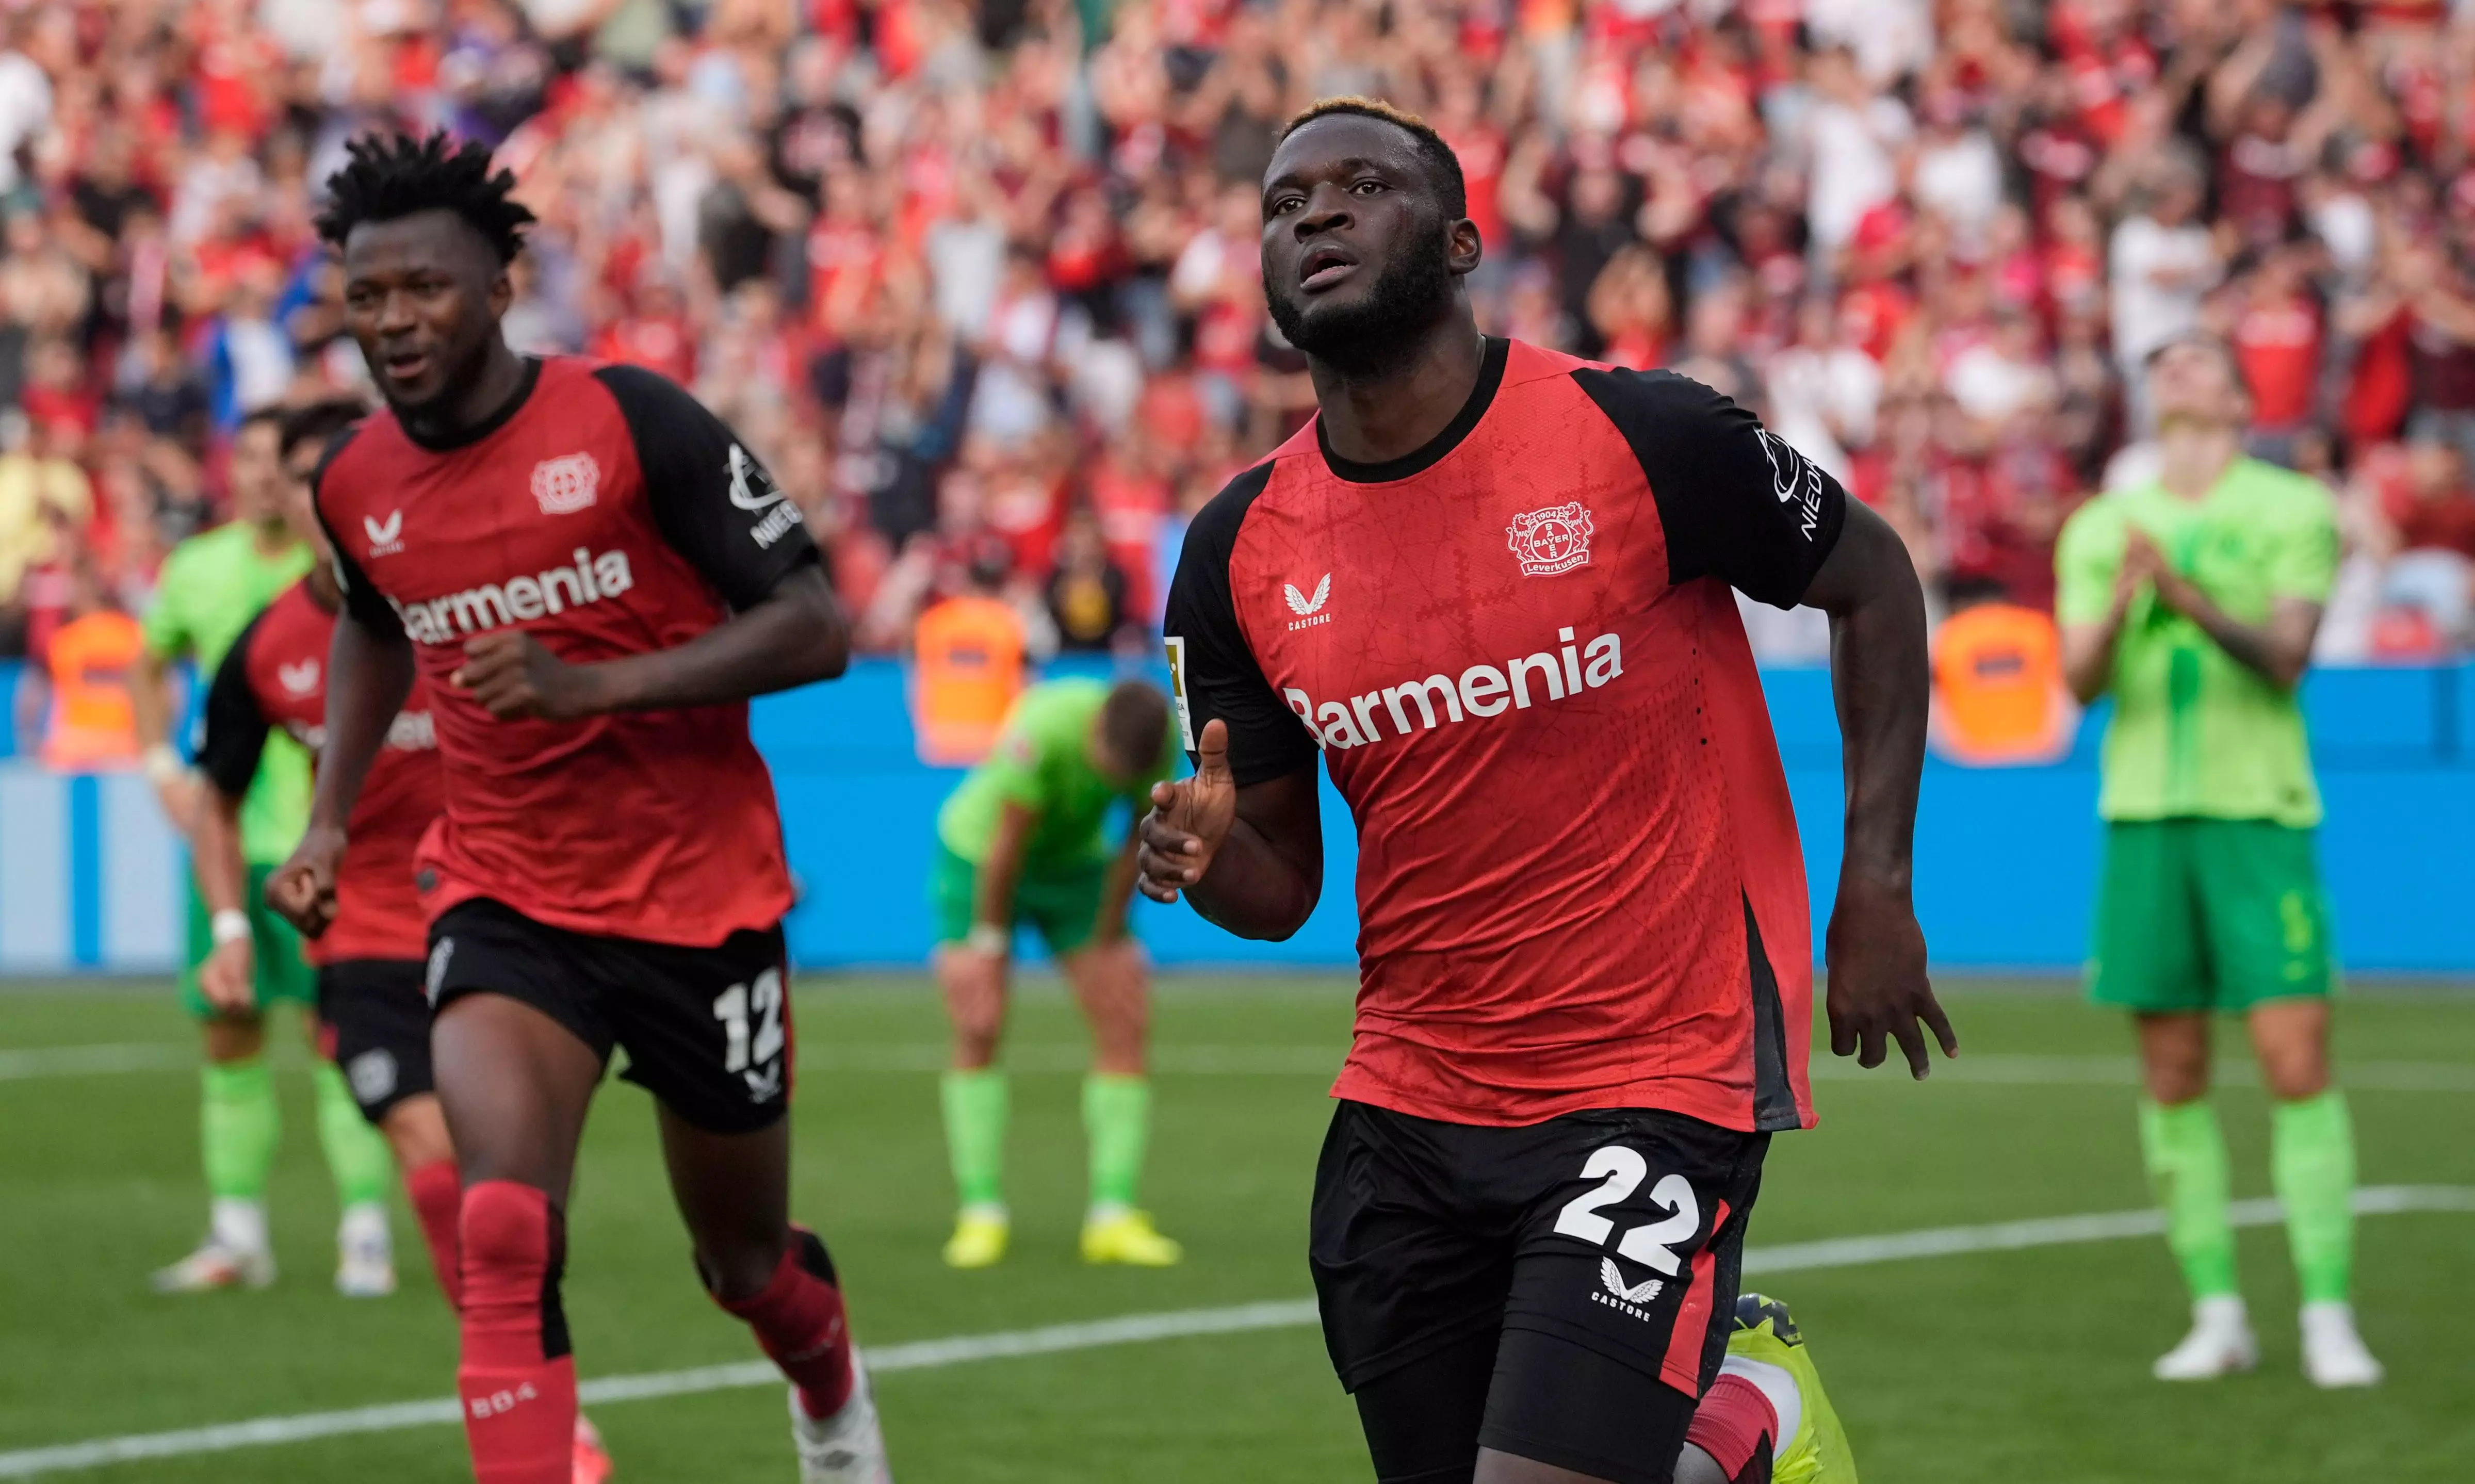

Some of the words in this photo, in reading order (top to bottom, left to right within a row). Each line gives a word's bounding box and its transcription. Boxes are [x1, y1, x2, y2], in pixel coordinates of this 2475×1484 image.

[1537, 511, 1556, 520] 1904
[1534, 534, 1569, 548] BAYER
[1545, 523, 1558, 559] BAYER
[1526, 555, 1584, 572] Leverkusen
[1289, 613, 1330, 631] CASTORE
[1282, 626, 1624, 751] Barmenia
[713, 966, 785, 1073] 12
[1553, 1145, 1700, 1276] 22
[1591, 1292, 1651, 1322] CASTORE
